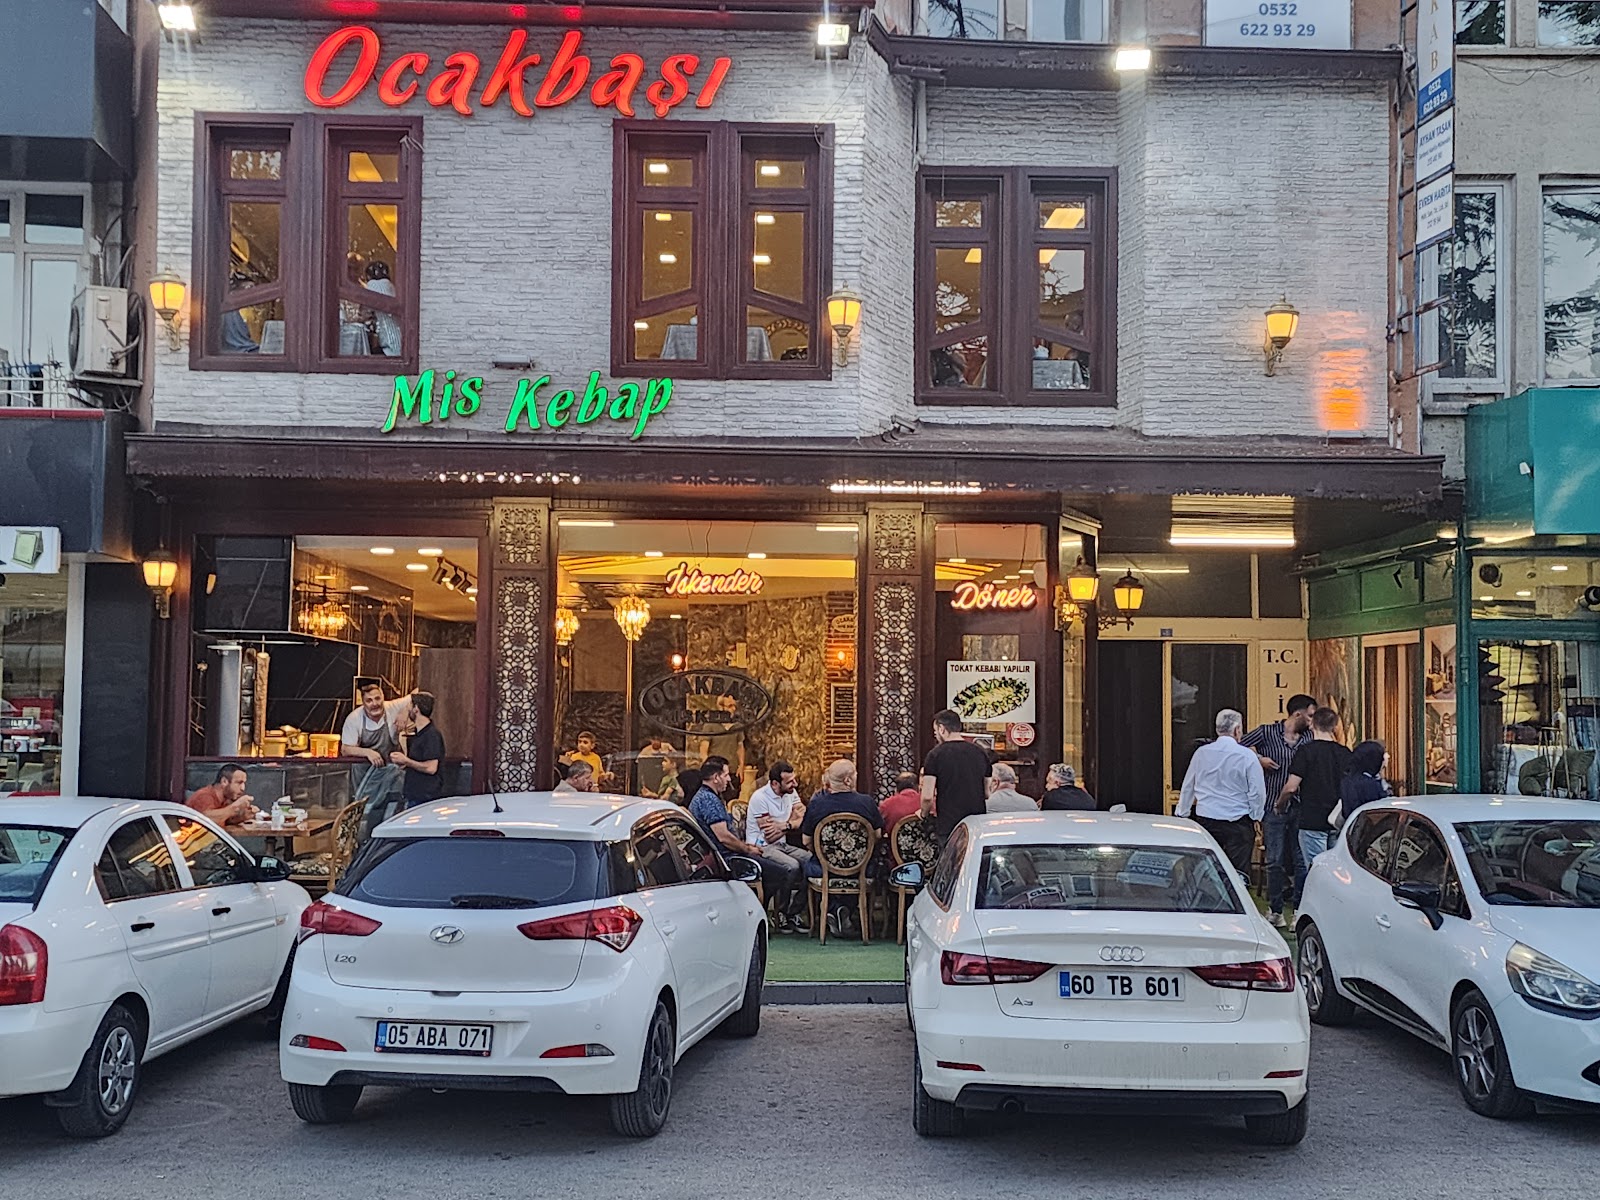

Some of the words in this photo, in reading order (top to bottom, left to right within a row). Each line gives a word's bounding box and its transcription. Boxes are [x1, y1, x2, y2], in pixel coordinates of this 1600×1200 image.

[1259, 3, 1297, 16] 0532
[1240, 23, 1269, 36] 622
[1273, 24, 1292, 36] 93
[1297, 24, 1316, 37] 29
[304, 25, 731, 117] Ocakbaşı
[380, 369, 484, 433] Mis
[504, 370, 674, 441] Kebap
[950, 581, 1036, 609] Döner
[1263, 649, 1299, 664] T.C.
[951, 664, 973, 673] TOKAT
[975, 664, 1001, 673] KEBABI
[1003, 665, 1030, 673] YAPILIR
[1071, 974, 1095, 995] 60
[1107, 976, 1133, 995] TB
[1145, 977, 1180, 997] 601
[388, 1025, 409, 1045] 05
[416, 1026, 448, 1047] ABA
[459, 1027, 487, 1048] 071
